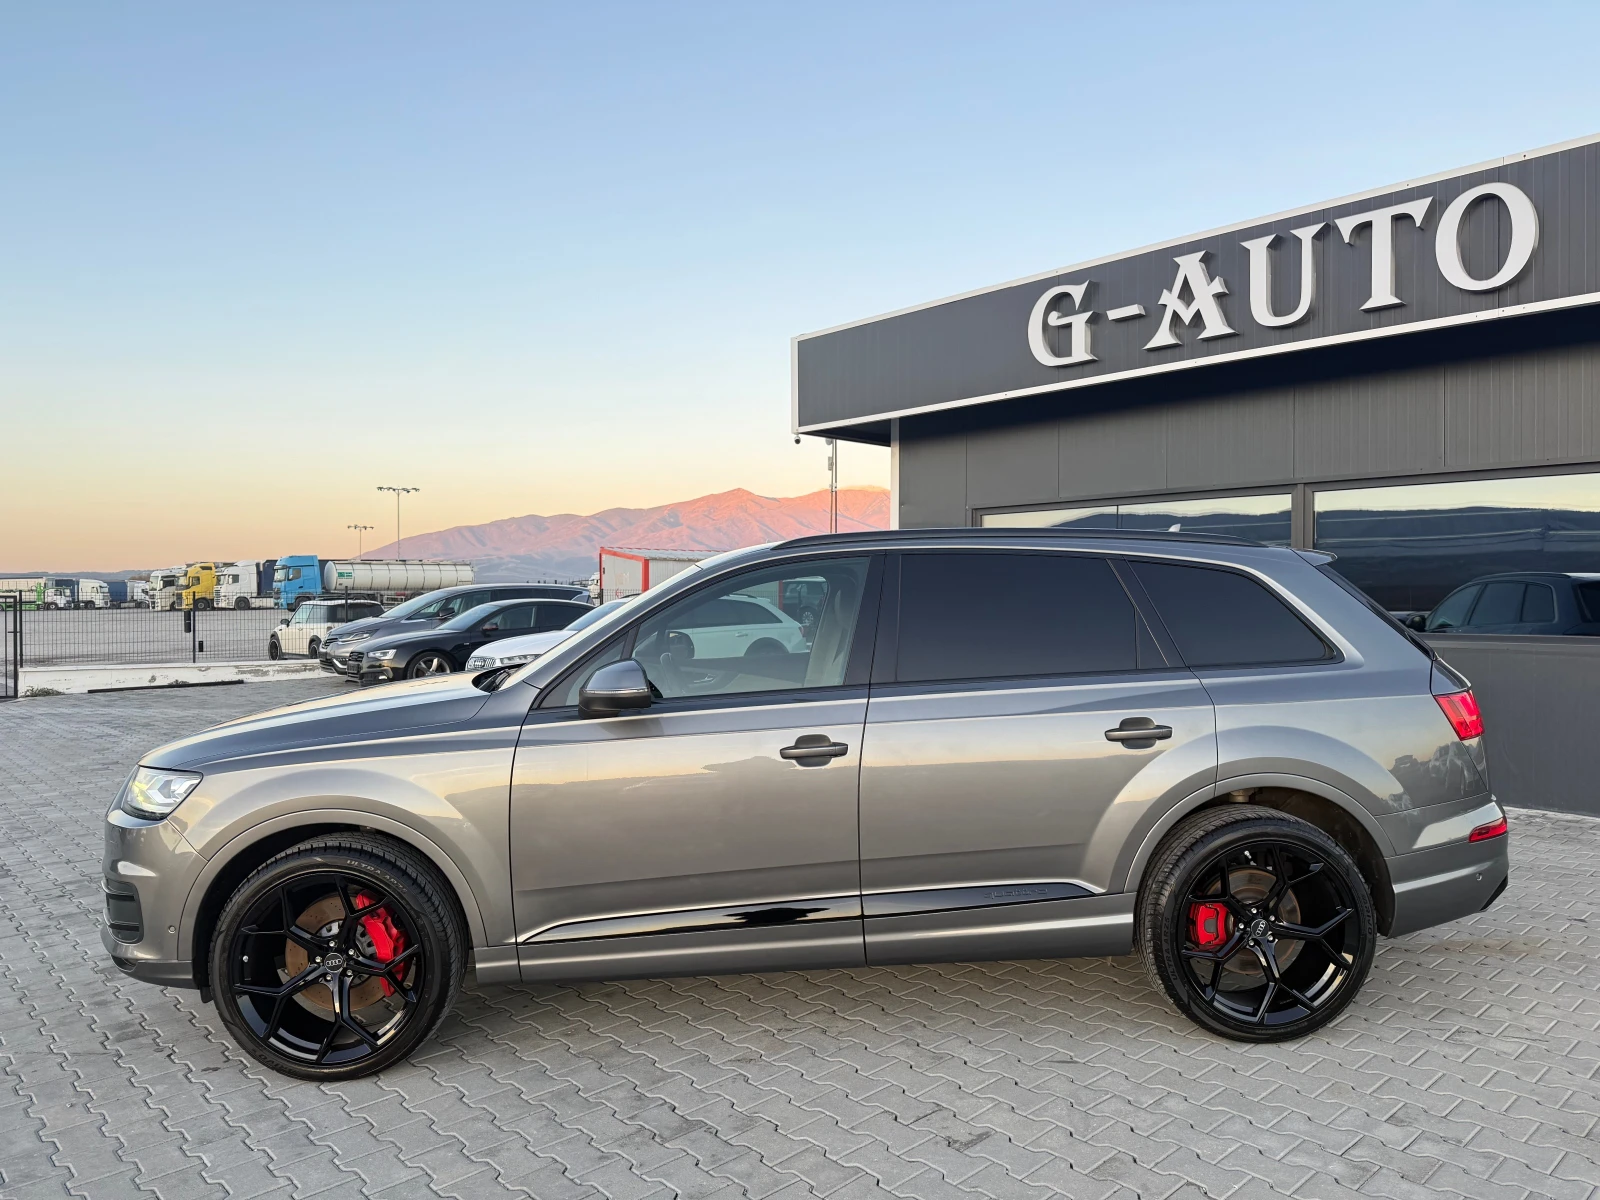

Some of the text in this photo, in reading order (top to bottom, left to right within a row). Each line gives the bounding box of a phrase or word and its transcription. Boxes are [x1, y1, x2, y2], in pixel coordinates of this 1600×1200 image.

[1027, 181, 1540, 368] G-AUTO
[346, 859, 381, 875] ULTRA
[984, 888, 1048, 899] quattro
[1163, 949, 1178, 981] ULTRA
